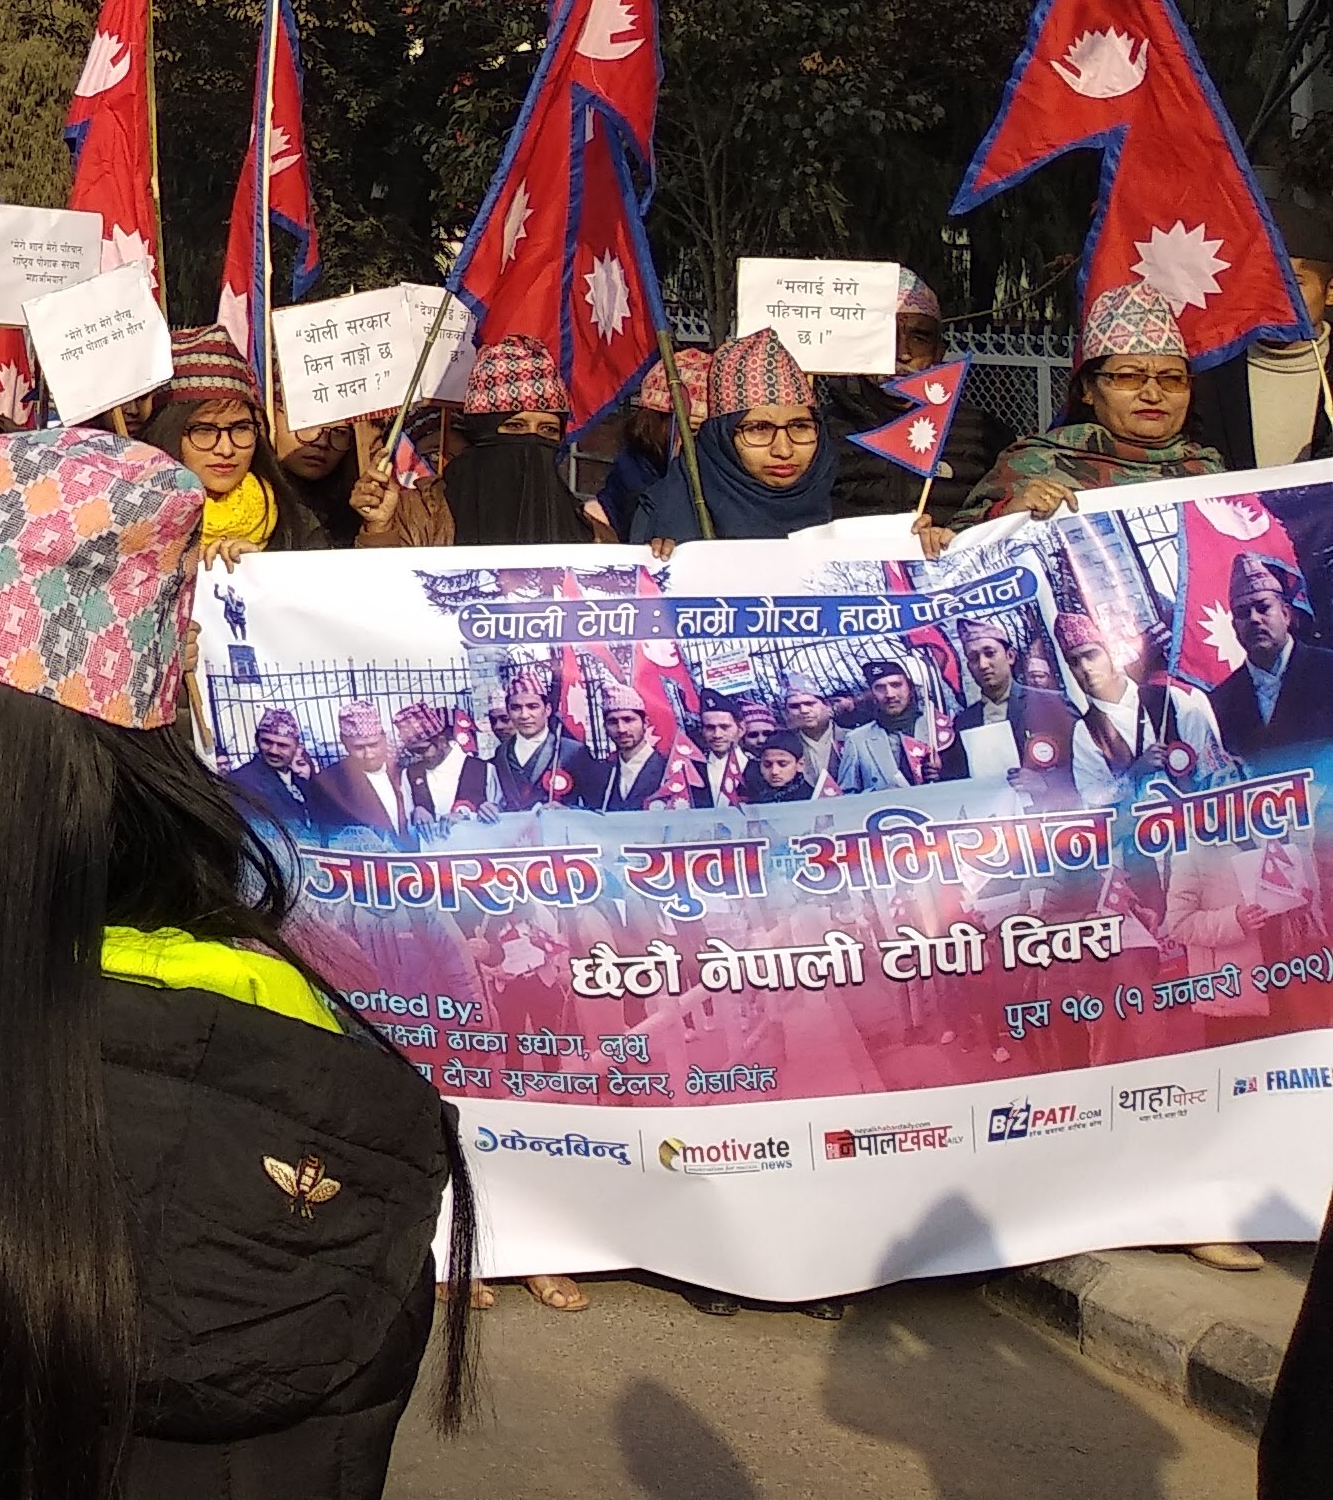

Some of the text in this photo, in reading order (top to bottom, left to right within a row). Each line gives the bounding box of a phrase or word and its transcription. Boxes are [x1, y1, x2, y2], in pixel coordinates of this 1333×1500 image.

[832, 277, 859, 296] मेरो
[345, 311, 392, 336] सरकार
[766, 300, 866, 321] पहिचान प्यारो
[797, 330, 812, 345] छ
[304, 353, 334, 376] किन
[377, 341, 393, 359] छ
[312, 383, 328, 404] यो
[336, 377, 367, 399] सदन
[577, 601, 639, 638] टोपी
[676, 598, 738, 638] हाम्रो
[837, 595, 901, 636] हाम्रो
[620, 837, 769, 922] युवा
[792, 804, 1117, 896] अभियान
[1132, 768, 1315, 860] नेपाल
[696, 928, 865, 993] नेपाली
[880, 924, 987, 981] टोपी
[1001, 911, 1125, 973] दिवस
[436, 995, 483, 1025] By:
[1004, 999, 1051, 1039] पुस
[1061, 994, 1104, 1022] १७
[1152, 963, 1241, 1010] जनवरी
[445, 1029, 508, 1053] ढाका
[442, 1058, 492, 1088] दौरा
[1266, 1067, 1333, 1091] FRAME
[683, 1137, 790, 1164] motivate
[760, 1159, 793, 1171] news
